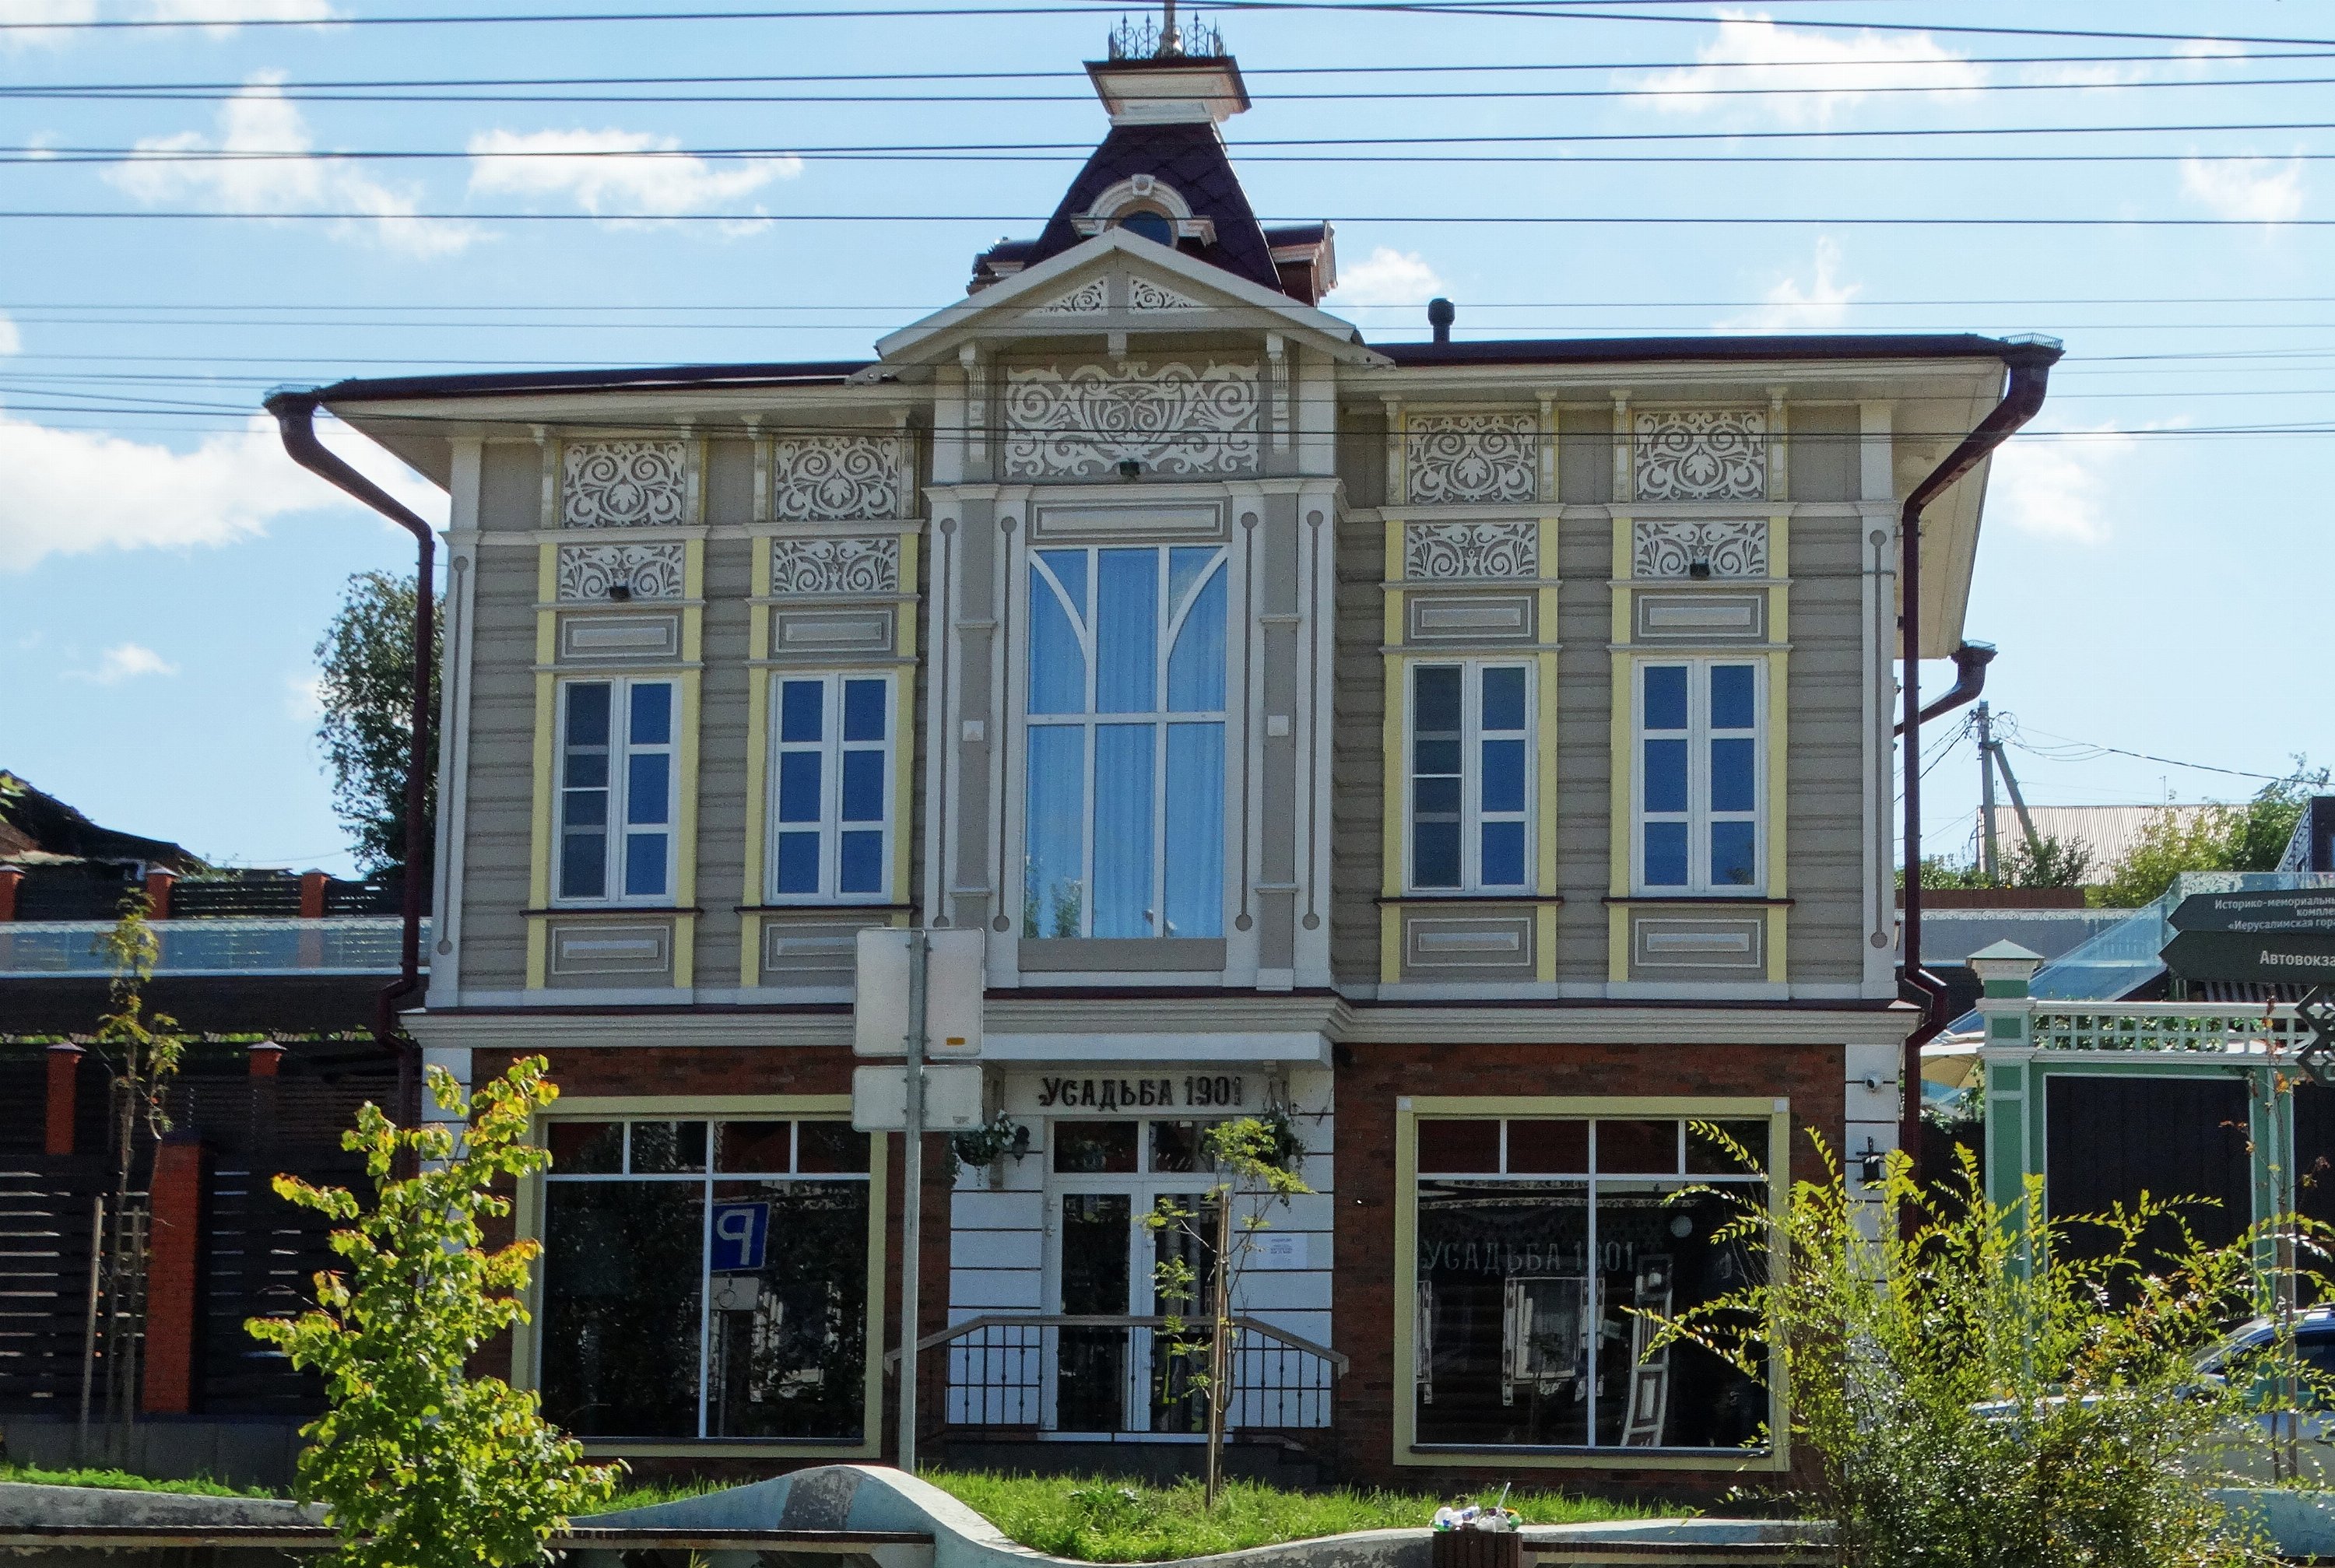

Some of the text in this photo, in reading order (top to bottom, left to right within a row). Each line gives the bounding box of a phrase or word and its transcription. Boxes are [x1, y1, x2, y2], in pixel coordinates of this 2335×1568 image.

[2228, 919, 2313, 932] «Иерусалимская
[2260, 950, 2335, 966] Автовокза
[1038, 1075, 1242, 1112] УСАДЬБА 1901
[1418, 1240, 1561, 1276] УСАДЬБА
